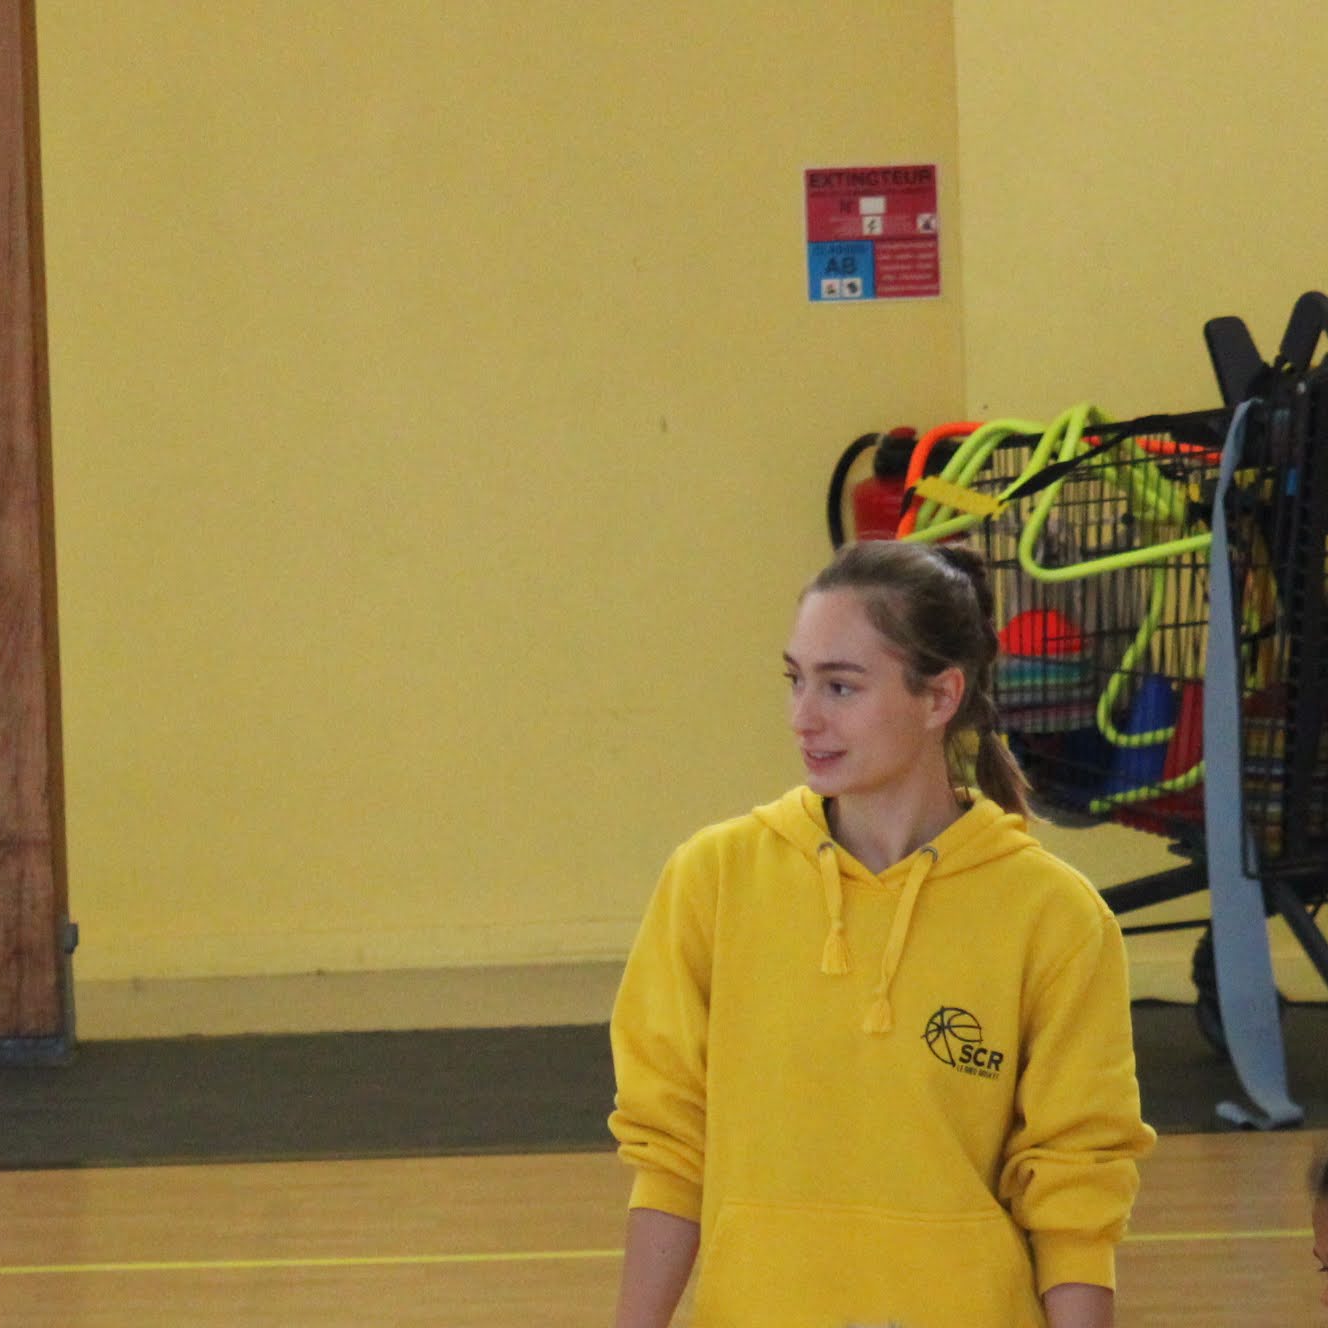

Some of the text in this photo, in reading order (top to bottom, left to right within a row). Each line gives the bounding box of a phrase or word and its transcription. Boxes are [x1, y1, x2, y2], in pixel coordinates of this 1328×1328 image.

[808, 168, 932, 188] EXTINCTEUR
[824, 256, 858, 275] AB
[959, 1043, 1004, 1071] SCR
